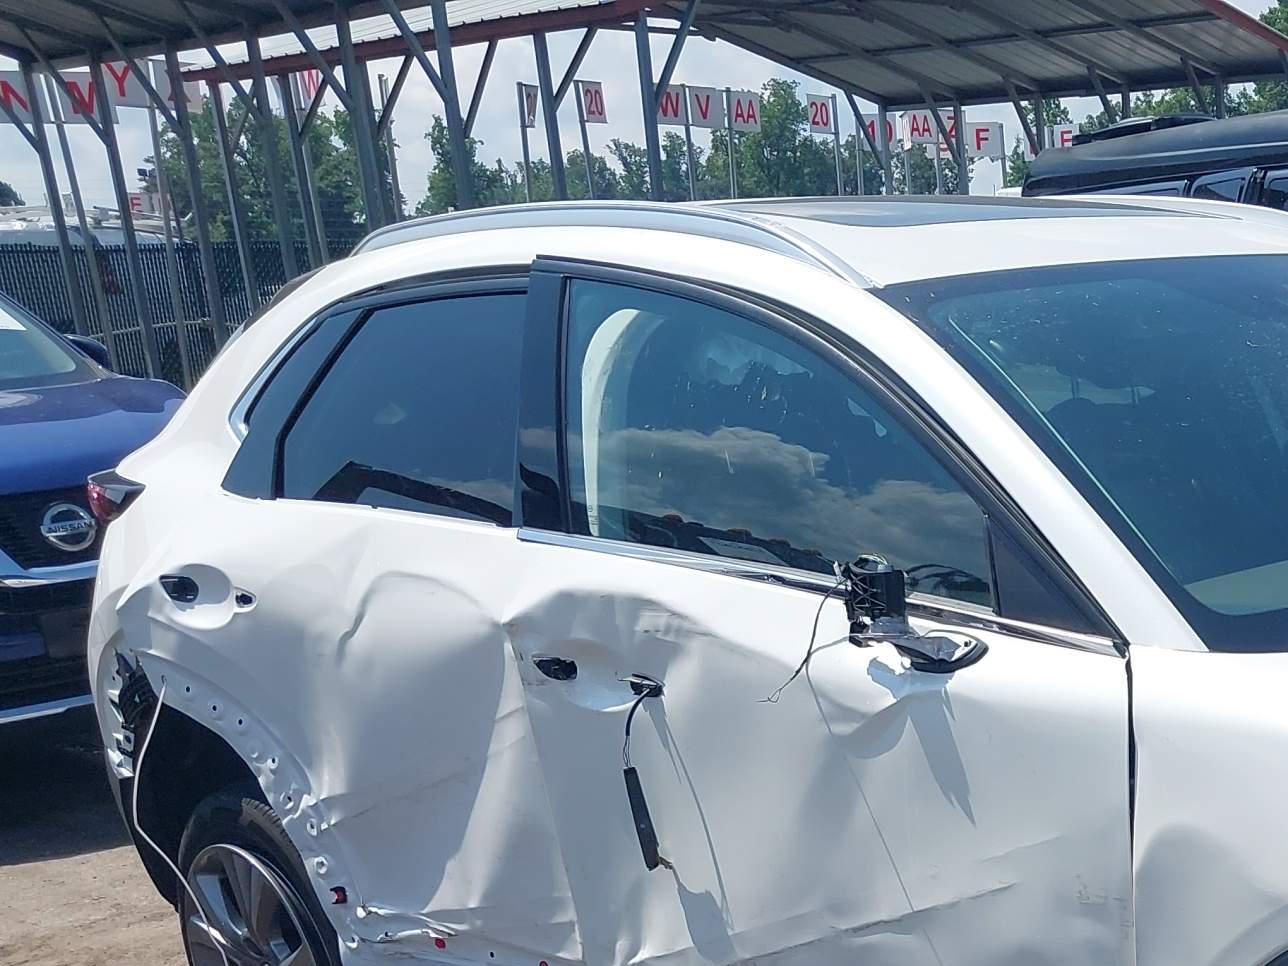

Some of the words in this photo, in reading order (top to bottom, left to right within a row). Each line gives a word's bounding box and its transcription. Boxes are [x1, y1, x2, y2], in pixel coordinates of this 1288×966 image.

[104, 62, 130, 97] Y
[585, 88, 604, 116] 20
[695, 93, 711, 120] V
[735, 98, 758, 125] AA
[810, 101, 829, 127] 20
[911, 114, 933, 138] AA
[976, 128, 990, 151] F
